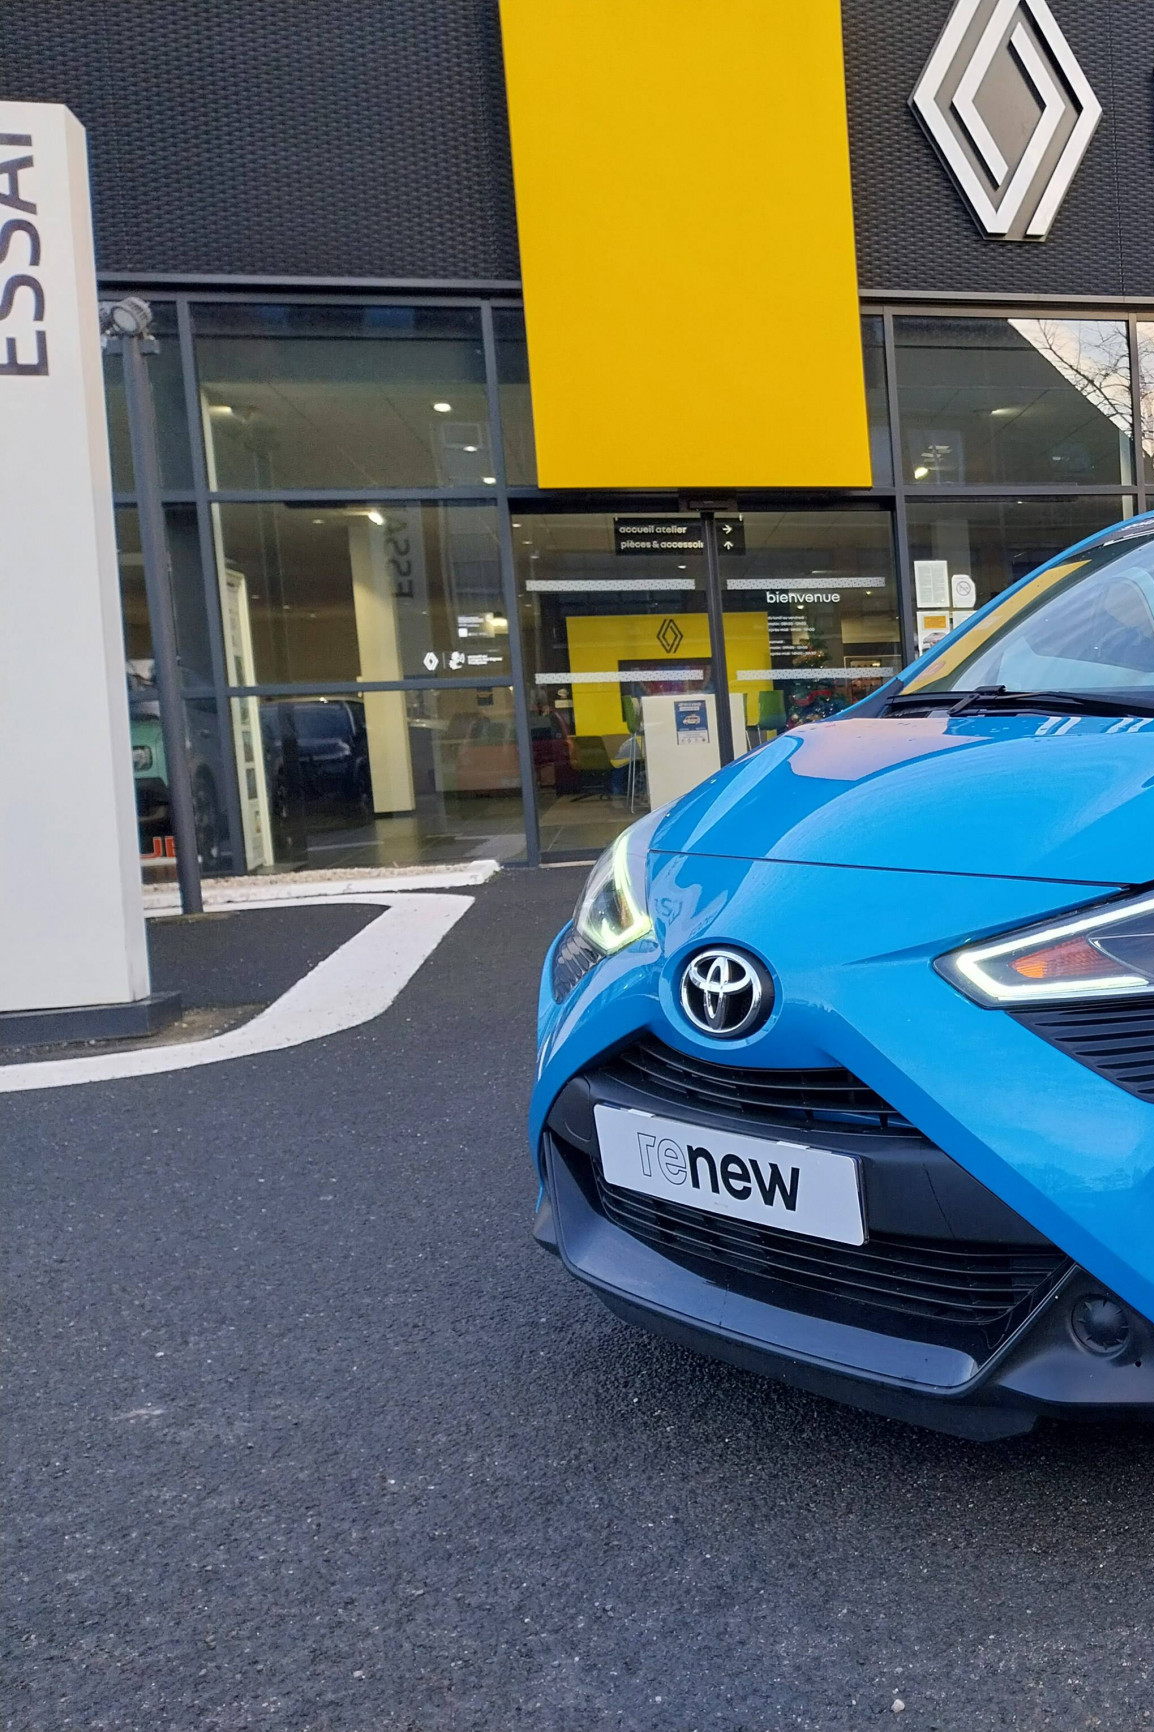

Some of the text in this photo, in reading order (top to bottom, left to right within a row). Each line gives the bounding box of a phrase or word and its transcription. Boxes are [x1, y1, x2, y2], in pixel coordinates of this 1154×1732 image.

[619, 524, 688, 534] accueil atelier
[620, 540, 704, 550] pièces & accessoi
[766, 591, 841, 604] bienvenue
[637, 1132, 800, 1212] renew
